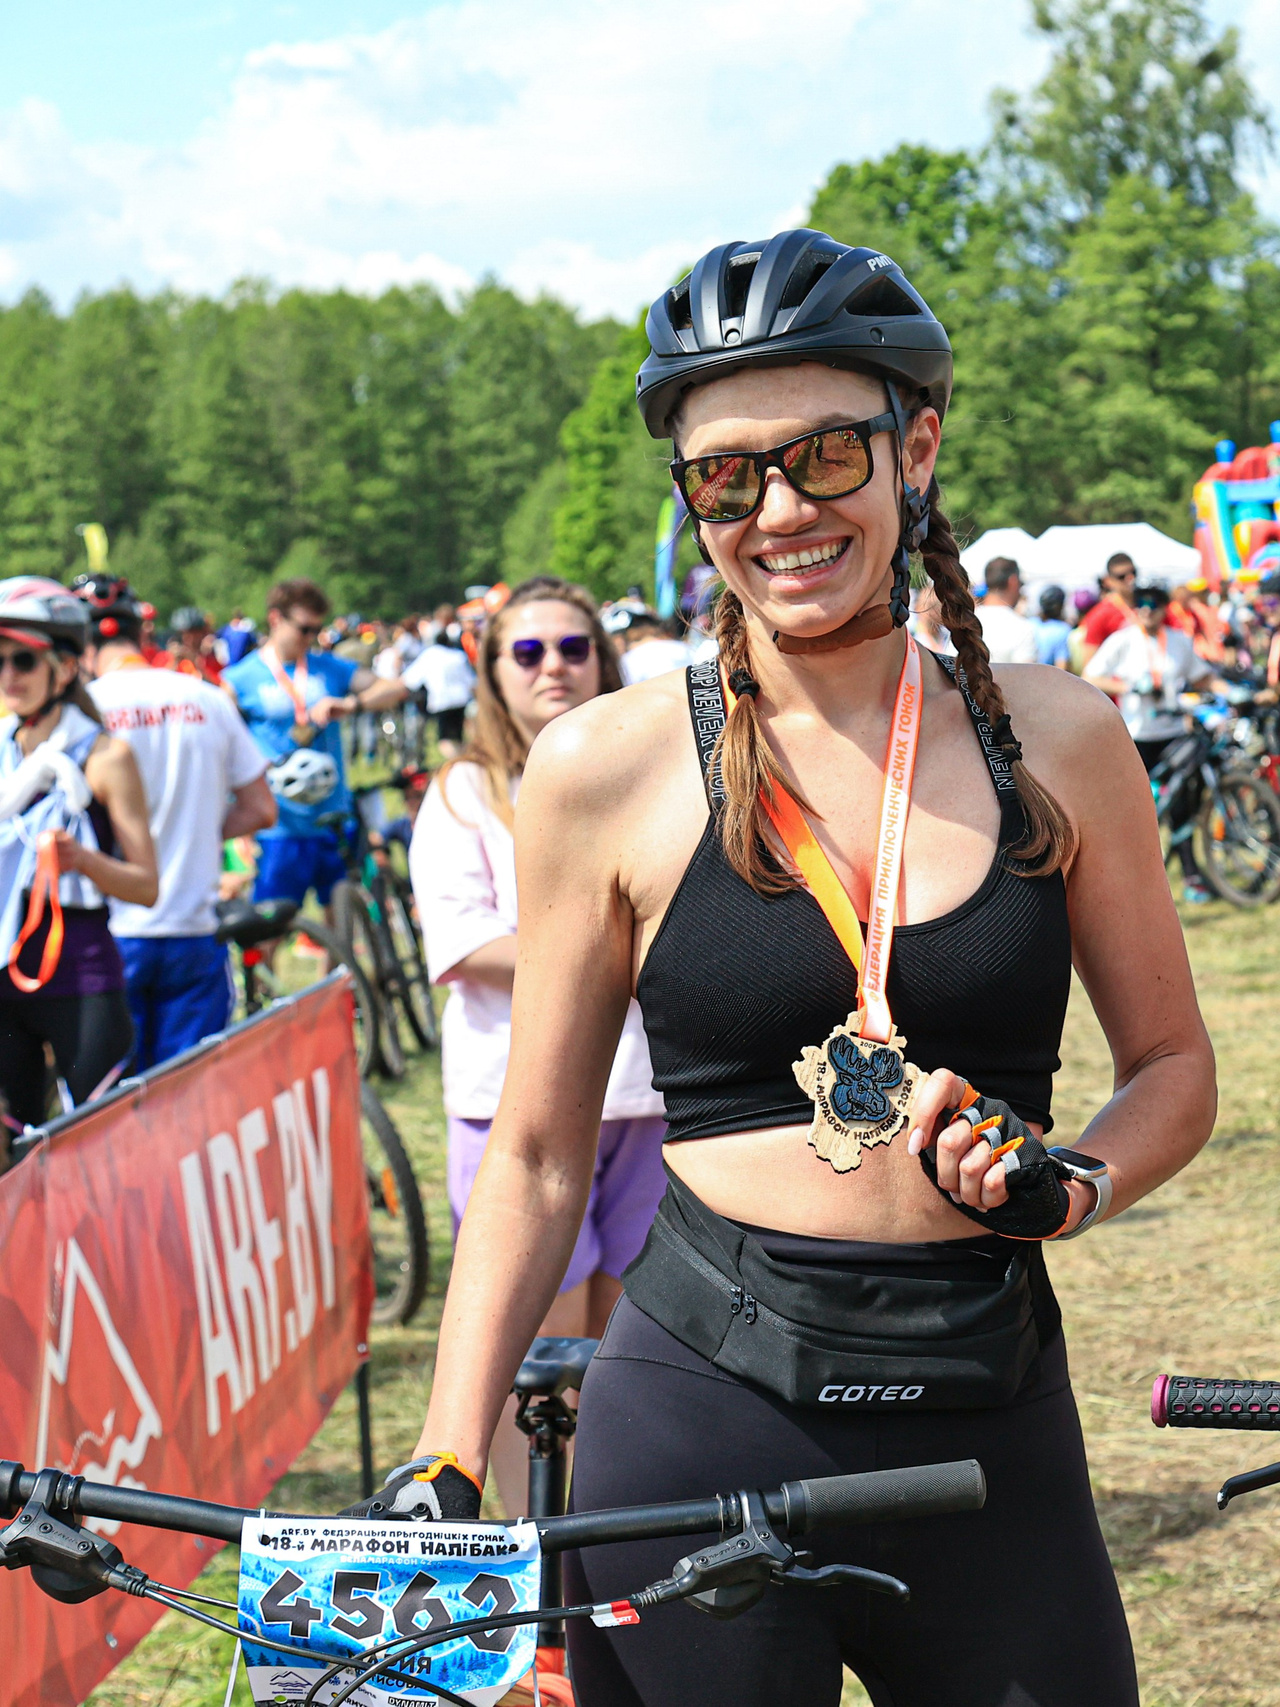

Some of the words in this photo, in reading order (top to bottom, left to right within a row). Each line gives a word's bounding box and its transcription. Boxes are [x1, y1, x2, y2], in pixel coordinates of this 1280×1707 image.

[877, 738, 909, 901] ПРИКЛЮЧЕНЧЕСКИХ
[898, 682, 917, 734] ГОНОК
[859, 1040, 878, 1050] 2009
[816, 1084, 851, 1137] МАРАФОН
[897, 1079, 913, 1108] 2026
[180, 1067, 336, 1436] ARF.BY
[818, 1385, 925, 1402] GOTEO
[281, 1528, 317, 1536] ARF.BY
[322, 1529, 387, 1537] ФЕДЭРАЦЫЯ
[471, 1534, 505, 1542] ГОНАК
[310, 1538, 409, 1554] МАРАФОН
[340, 1555, 418, 1565] ВЕЛАМАРАФОН
[259, 1567, 518, 1653] 4563
